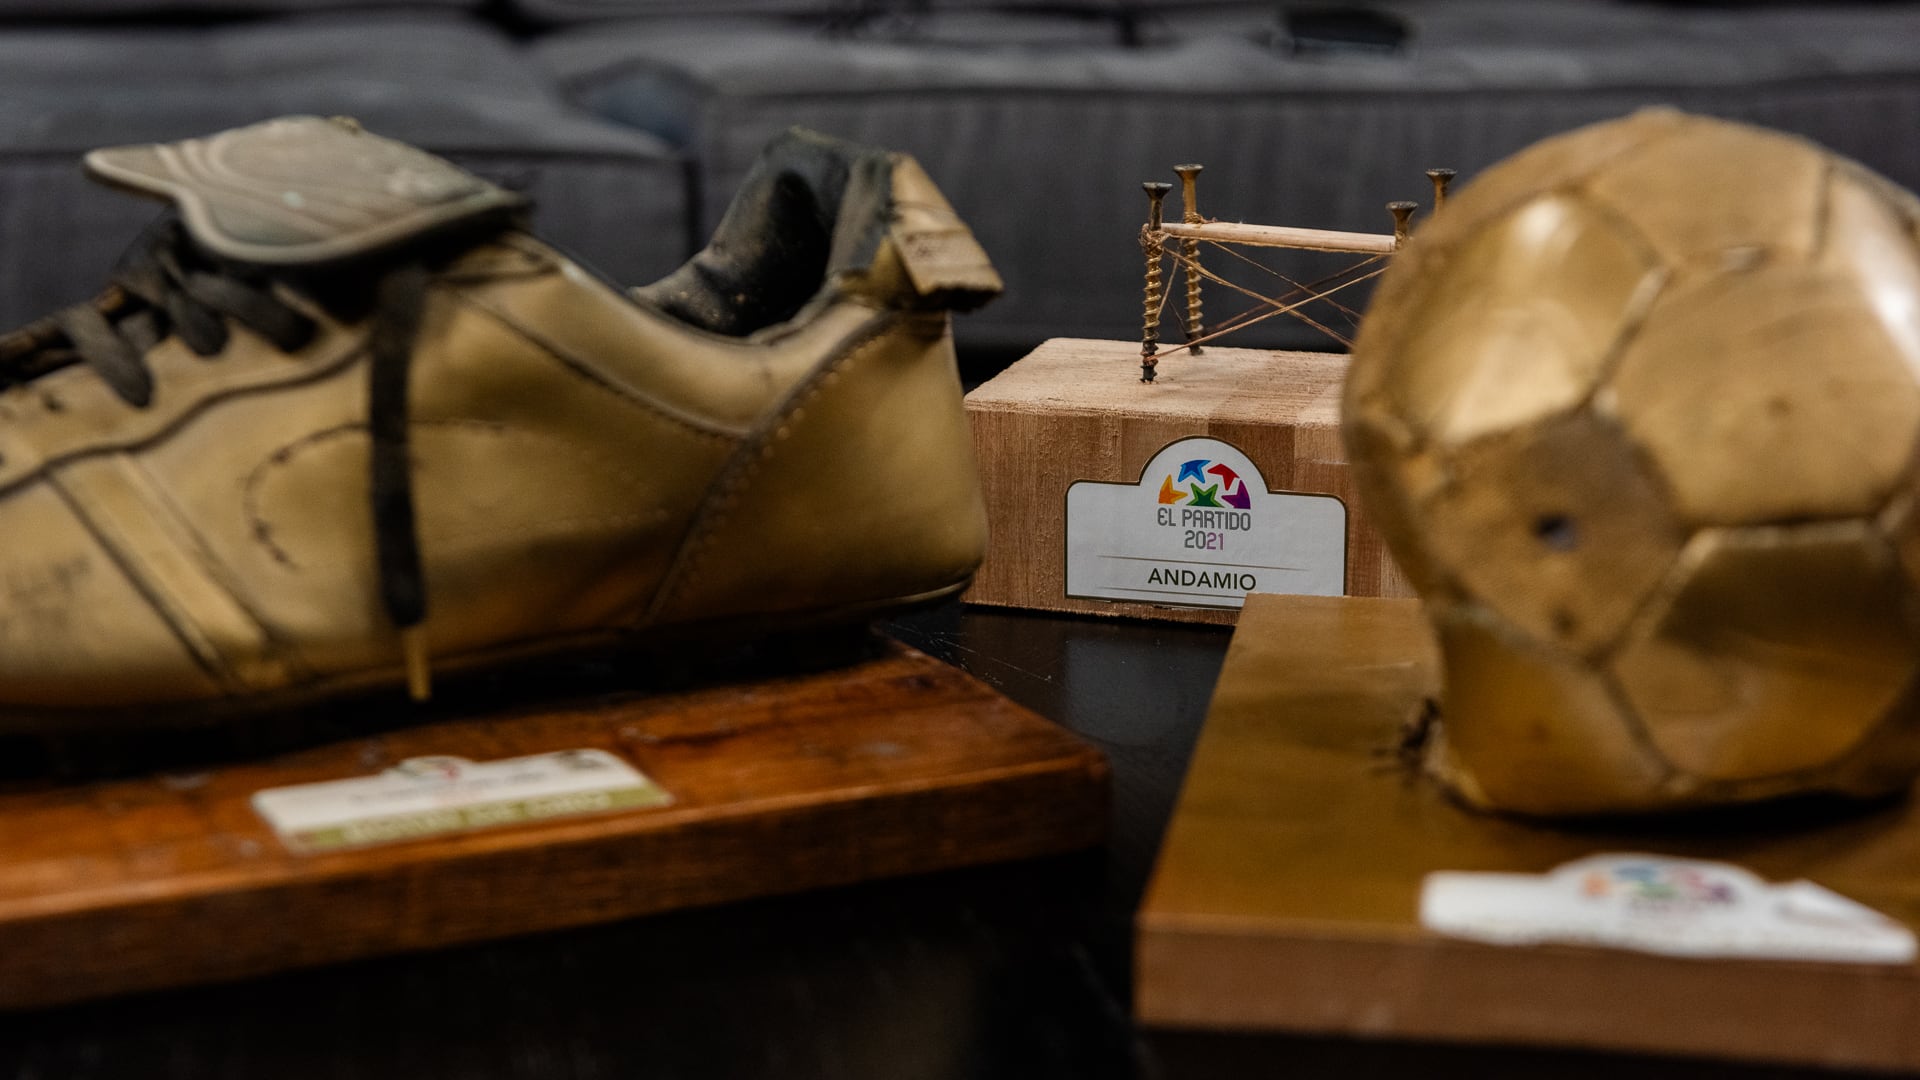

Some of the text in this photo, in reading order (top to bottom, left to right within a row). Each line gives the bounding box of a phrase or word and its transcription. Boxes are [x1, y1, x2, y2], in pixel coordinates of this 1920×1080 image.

[1157, 507, 1251, 531] EL PARTIDO
[1184, 531, 1224, 551] 2021
[1147, 567, 1257, 591] ANDAMIO
